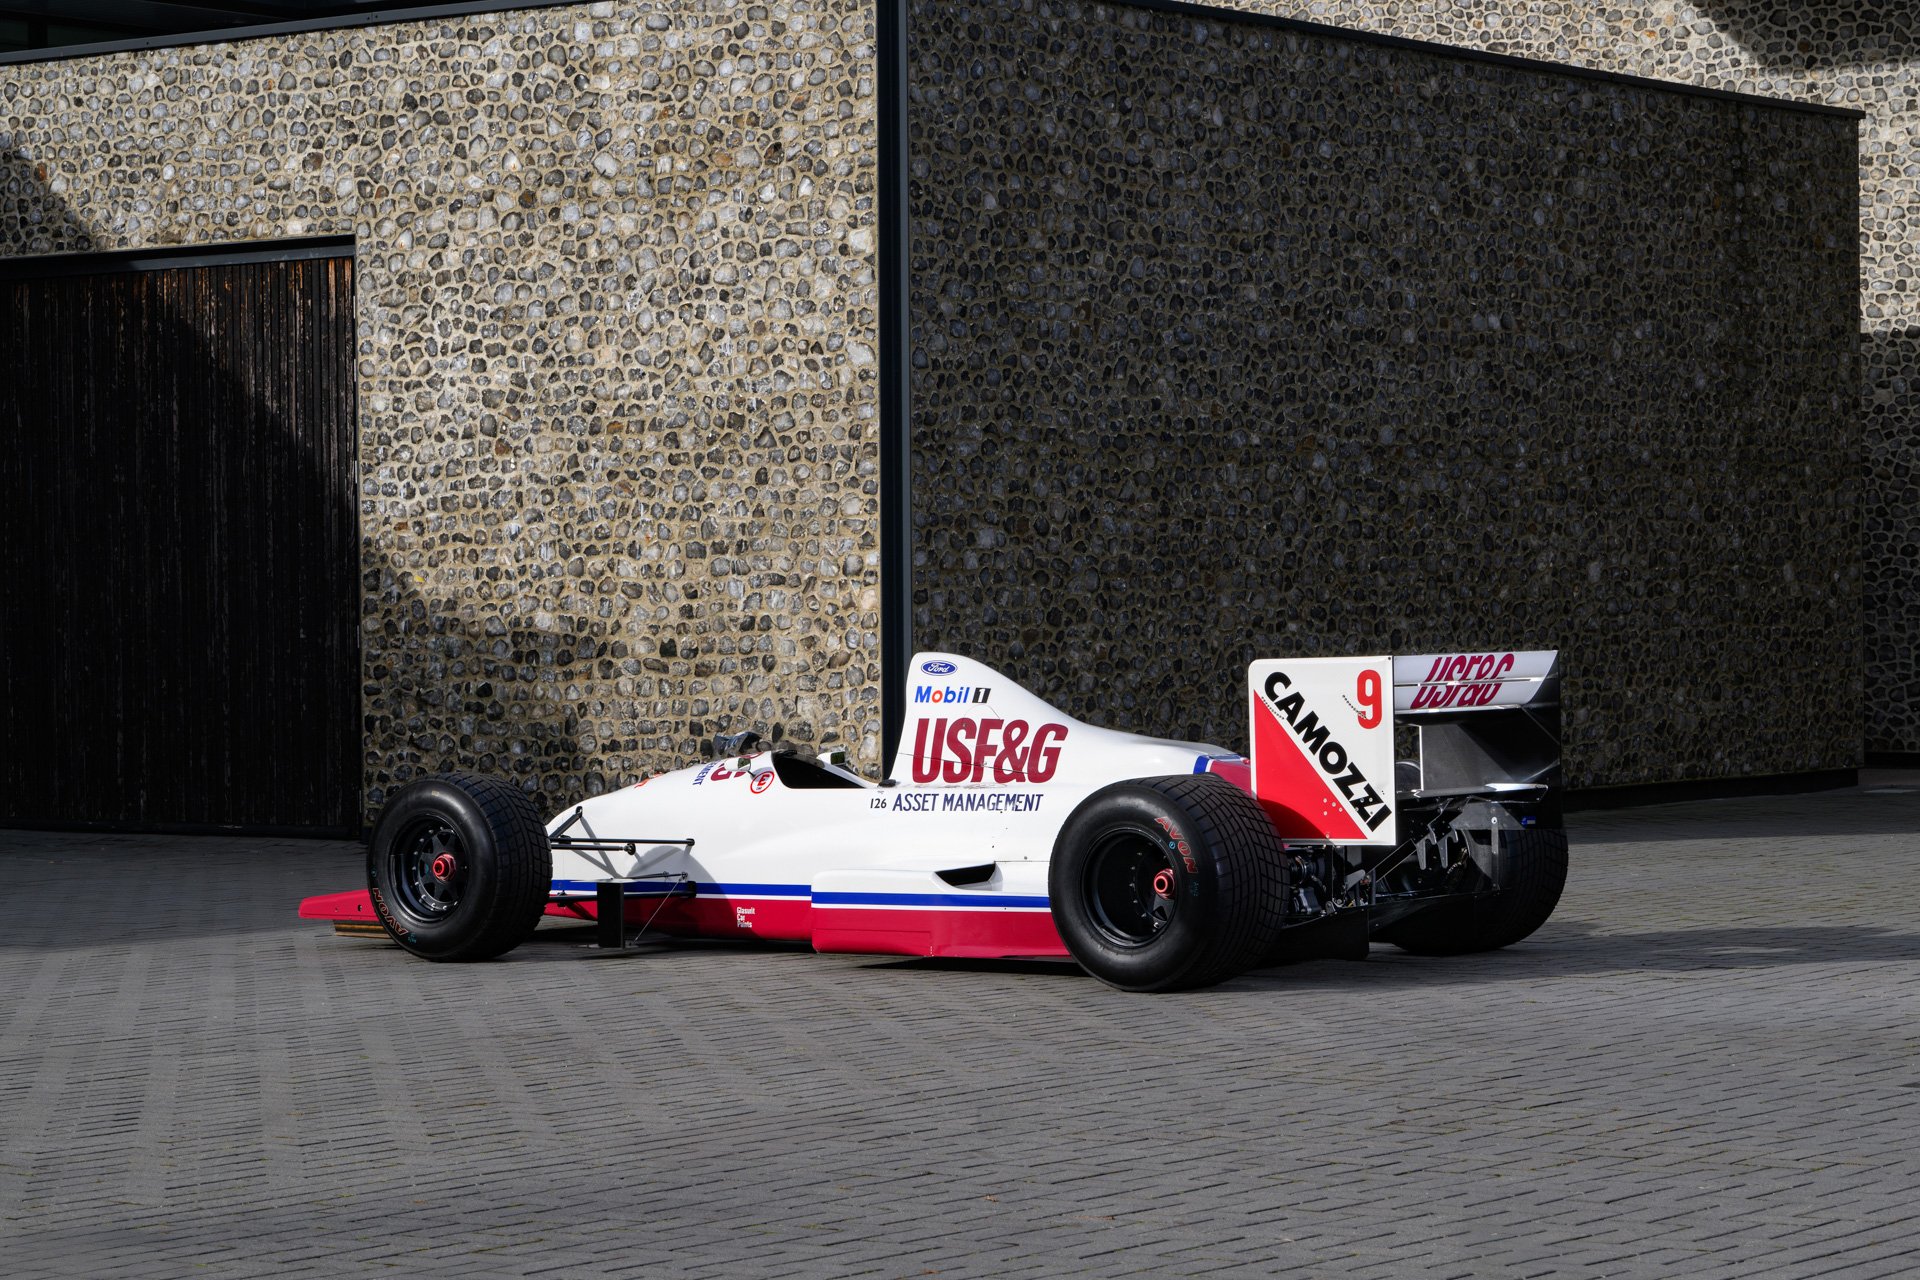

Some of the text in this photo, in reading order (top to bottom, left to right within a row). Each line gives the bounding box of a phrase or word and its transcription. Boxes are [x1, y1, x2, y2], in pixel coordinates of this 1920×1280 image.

[926, 662, 952, 674] Ford
[915, 686, 988, 703] Mobil 1
[1357, 669, 1382, 729] 9
[912, 717, 1069, 784] USF&G
[1264, 671, 1392, 832] CAMOZZI
[756, 774, 770, 787] E
[870, 794, 1044, 812] 126 ASSET MANAGEMENT
[1153, 817, 1199, 873] AVON
[372, 887, 409, 936] AVON
